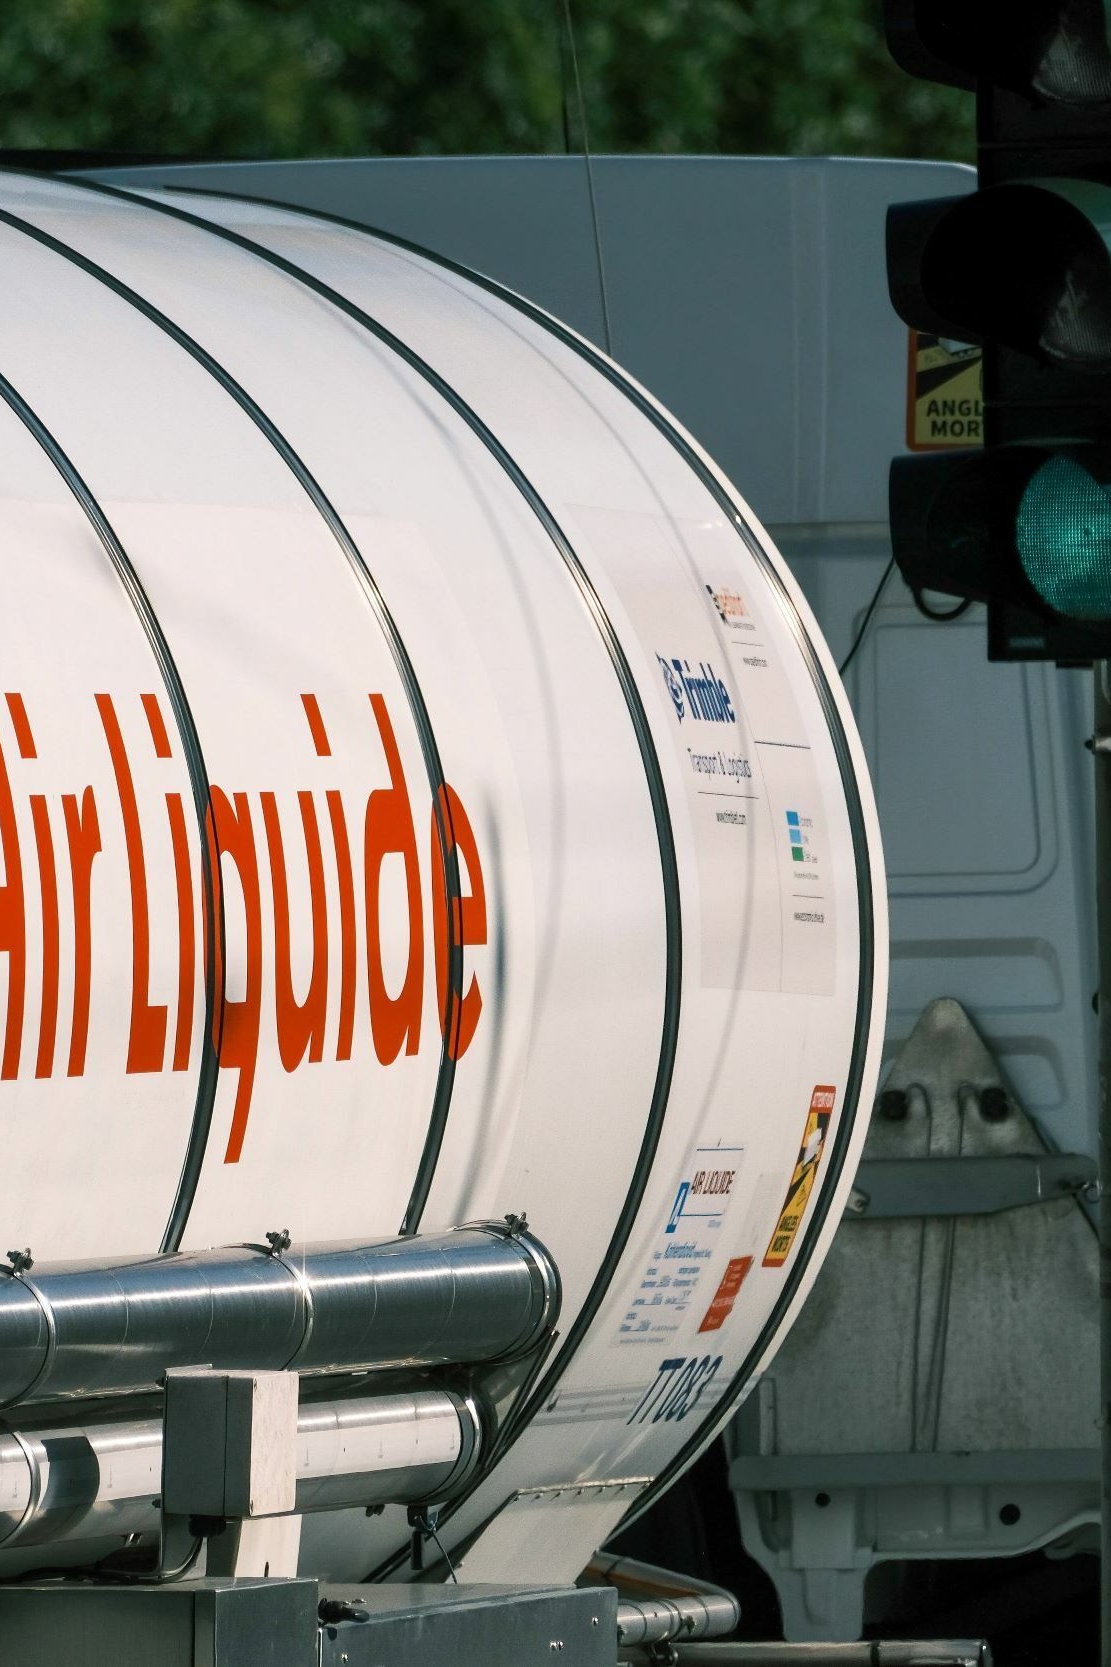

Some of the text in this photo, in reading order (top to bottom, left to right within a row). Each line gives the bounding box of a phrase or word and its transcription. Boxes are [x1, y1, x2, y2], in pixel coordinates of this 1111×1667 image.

[927, 400, 983, 417] ANGL
[931, 420, 983, 437] MOR
[672, 659, 735, 723] Trimble
[94, 693, 487, 1164] Liquide
[691, 1171, 736, 1194] AIR LIQUIDE
[626, 1355, 723, 1425] TT083
